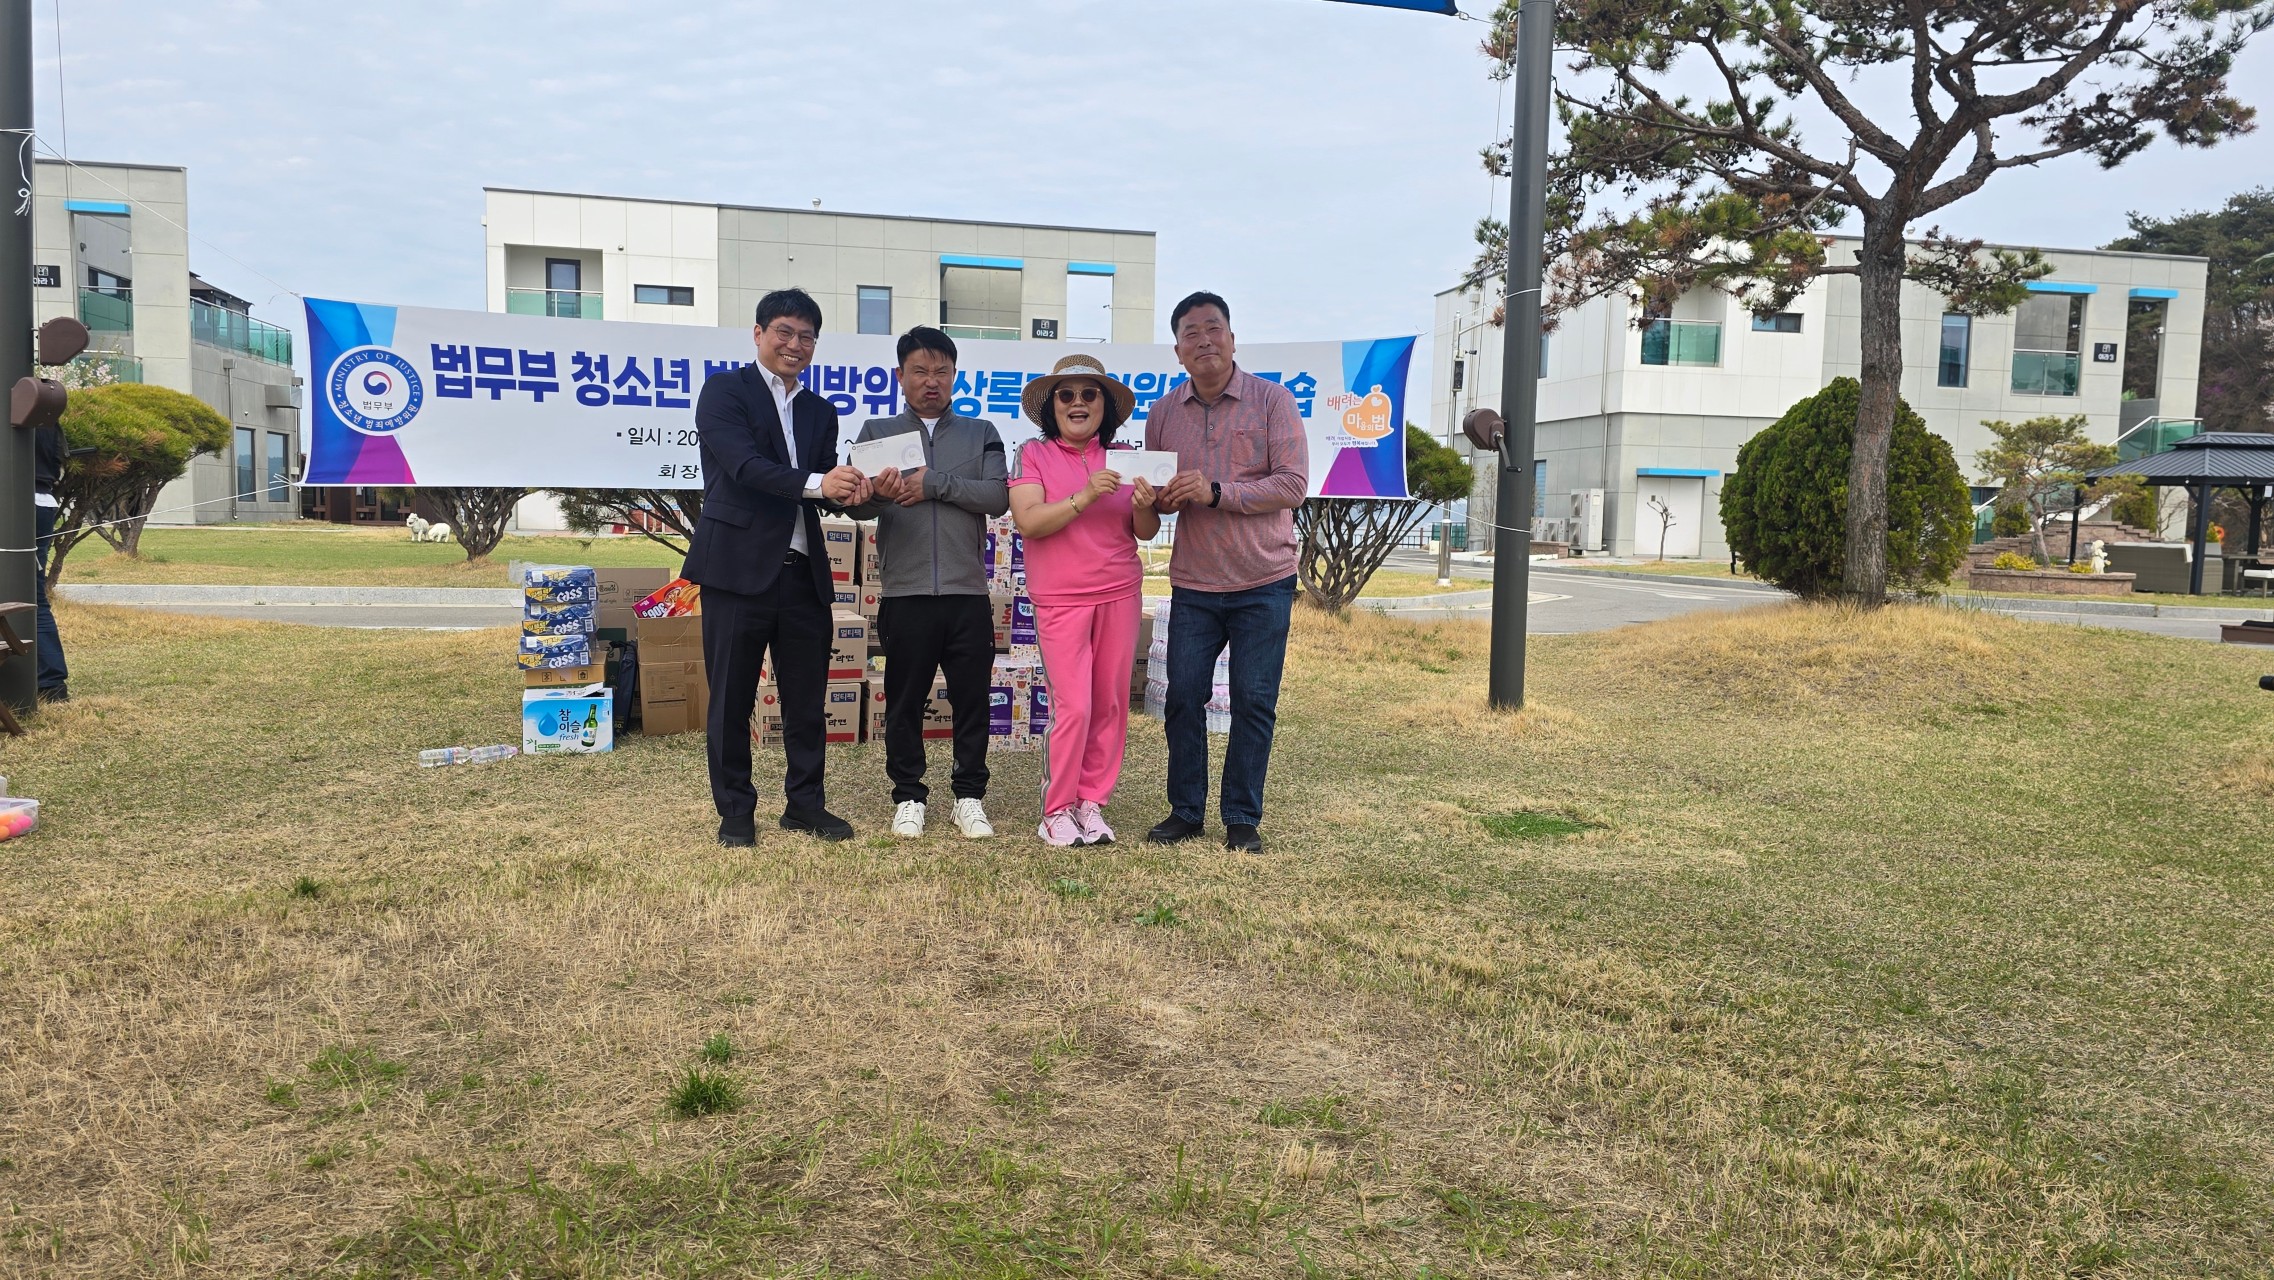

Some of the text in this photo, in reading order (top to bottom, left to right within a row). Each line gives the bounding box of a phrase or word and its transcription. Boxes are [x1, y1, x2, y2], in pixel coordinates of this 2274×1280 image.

[334, 352, 420, 396] MINISTRY OF JUSTICE
[430, 343, 559, 403] 법무부
[571, 350, 691, 409] 청소년
[338, 400, 362, 424] 청소년
[362, 400, 393, 411] 법무부
[627, 427, 661, 446] 일시
[828, 532, 851, 542] 멀티팩
[558, 733, 580, 741] fresh
